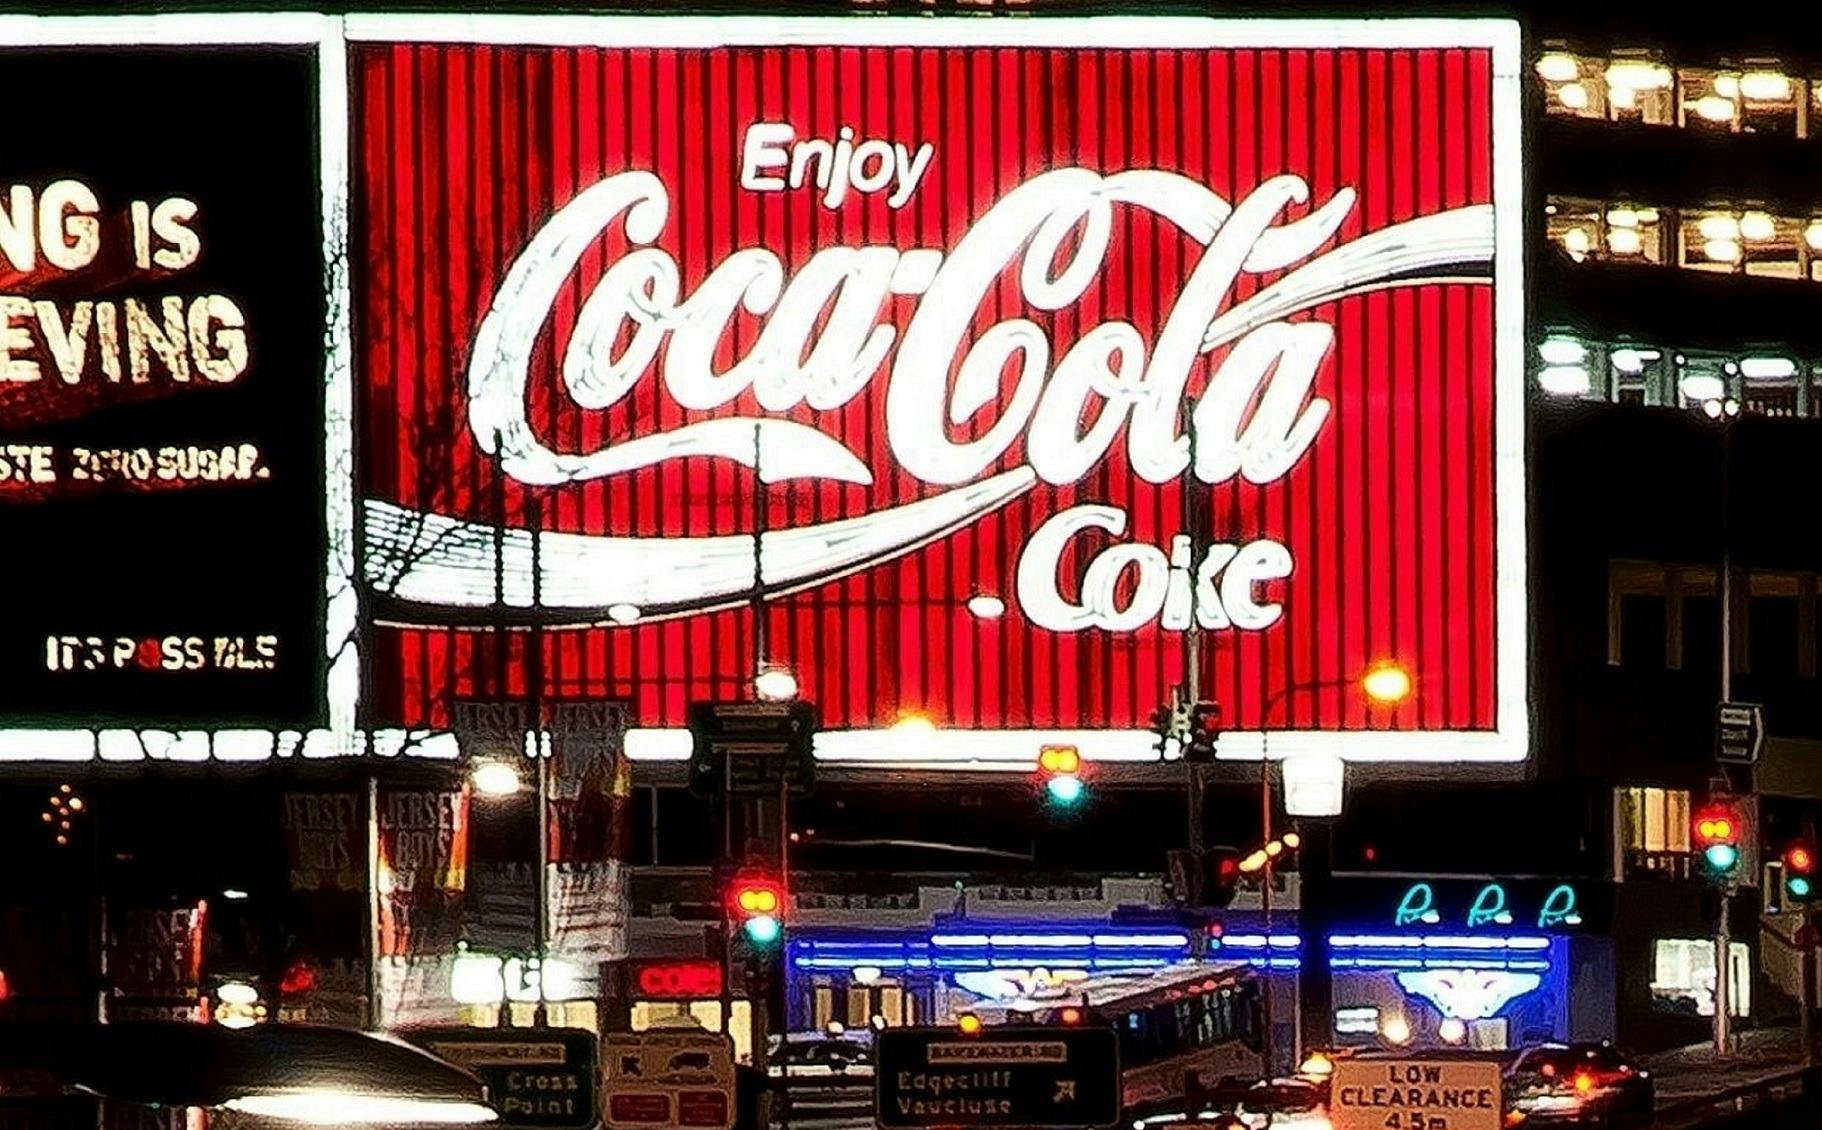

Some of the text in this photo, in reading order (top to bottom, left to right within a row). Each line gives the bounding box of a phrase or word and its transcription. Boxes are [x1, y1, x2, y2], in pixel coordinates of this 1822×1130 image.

[741, 123, 933, 210] Enjoy
[131, 197, 201, 270] IS
[468, 167, 1356, 486] Coca-Cola
[1016, 504, 1294, 632] Coke
[507, 1072, 579, 1090] Cross
[897, 1070, 1012, 1094] Edgecliff
[1389, 1065, 1441, 1083] LOW
[896, 1096, 1012, 1115] Vaucluse
[1340, 1088, 1493, 1108] CLEARANCE
